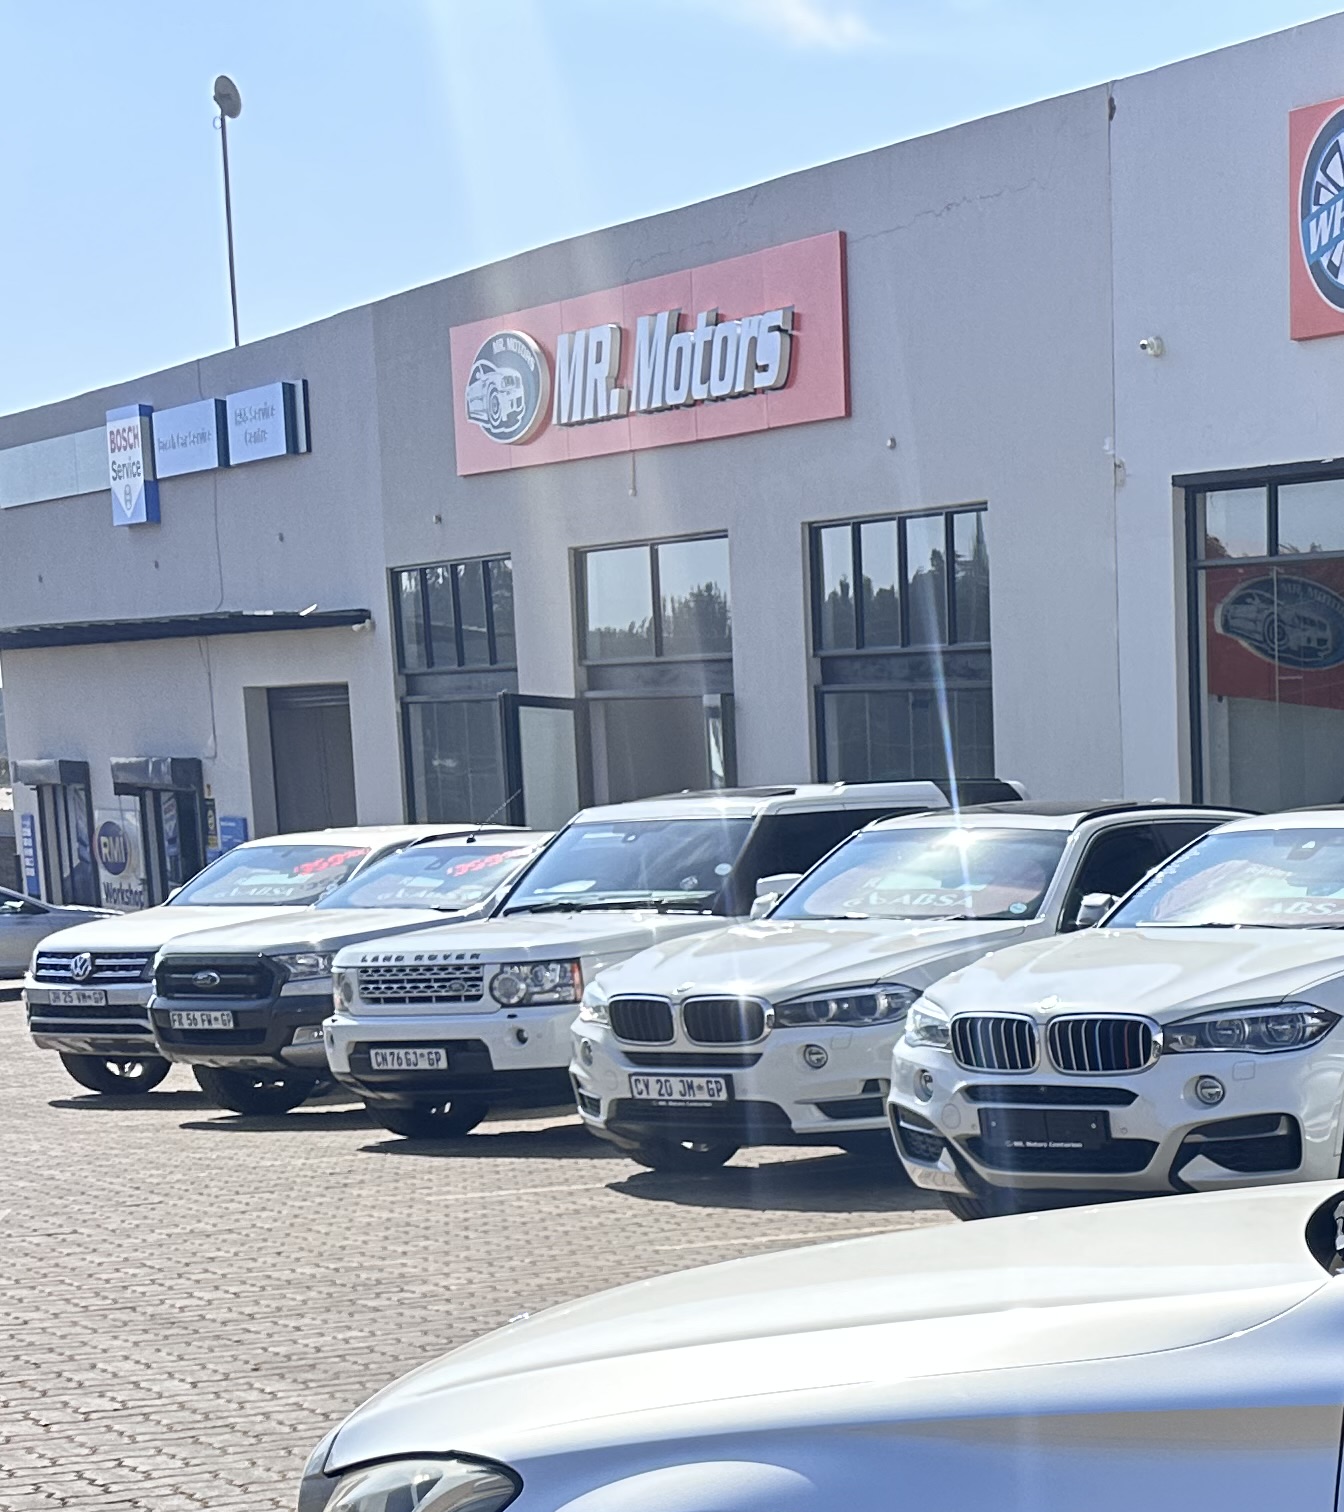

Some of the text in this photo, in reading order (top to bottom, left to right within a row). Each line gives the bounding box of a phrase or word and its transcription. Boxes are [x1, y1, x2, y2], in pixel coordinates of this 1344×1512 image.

[553, 305, 795, 427] MR. Motors
[109, 424, 139, 454] BOSCH
[111, 456, 142, 482] Service
[102, 881, 145, 908] Workshop
[886, 893, 973, 909] ABSA
[361, 952, 481, 963] LAND ROVER
[171, 1013, 184, 1027] FR
[186, 1013, 198, 1027] 56
[221, 1013, 233, 1028] GP
[374, 1051, 441, 1067] CN 76 GJ GP
[634, 1078, 723, 1097] CY 20 JM GP
